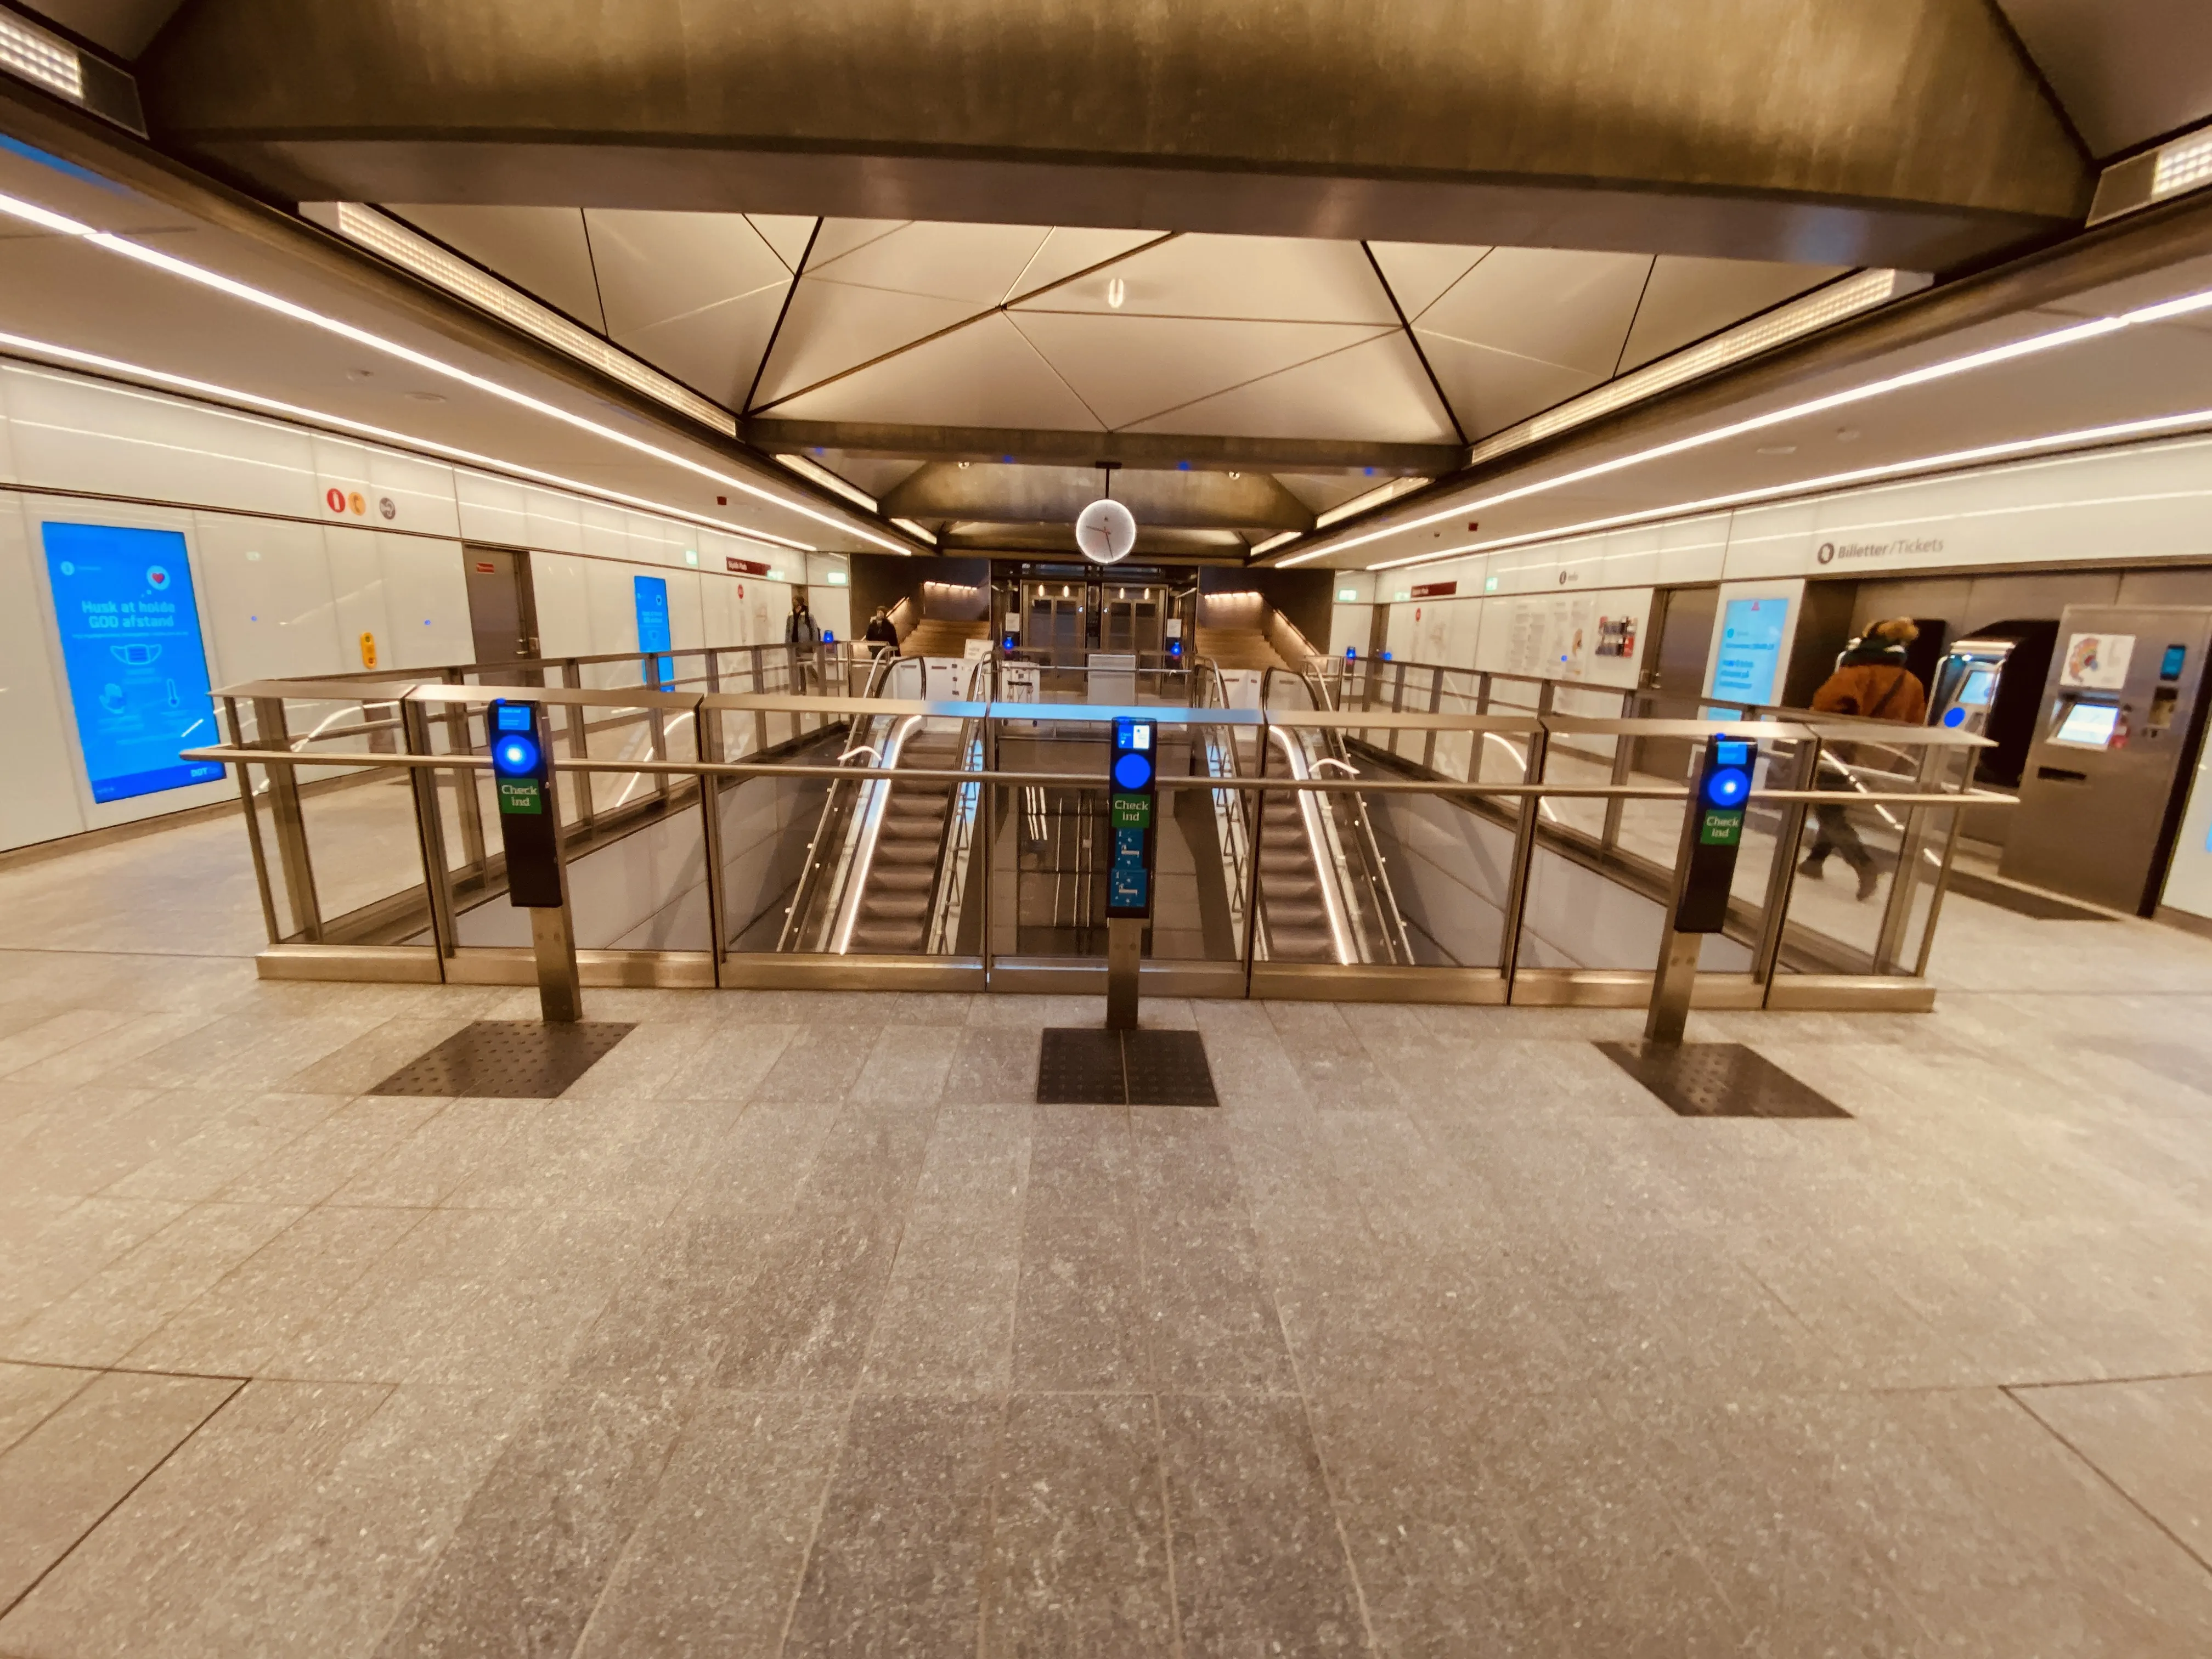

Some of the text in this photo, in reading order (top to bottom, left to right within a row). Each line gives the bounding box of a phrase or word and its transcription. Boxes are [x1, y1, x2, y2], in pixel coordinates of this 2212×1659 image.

[82, 601, 119, 613] Husk
[121, 601, 136, 613] at
[88, 614, 174, 628] GOD afstand
[501, 785, 538, 795] Check
[1114, 800, 1149, 810] Check
[1706, 816, 1739, 827] Check
